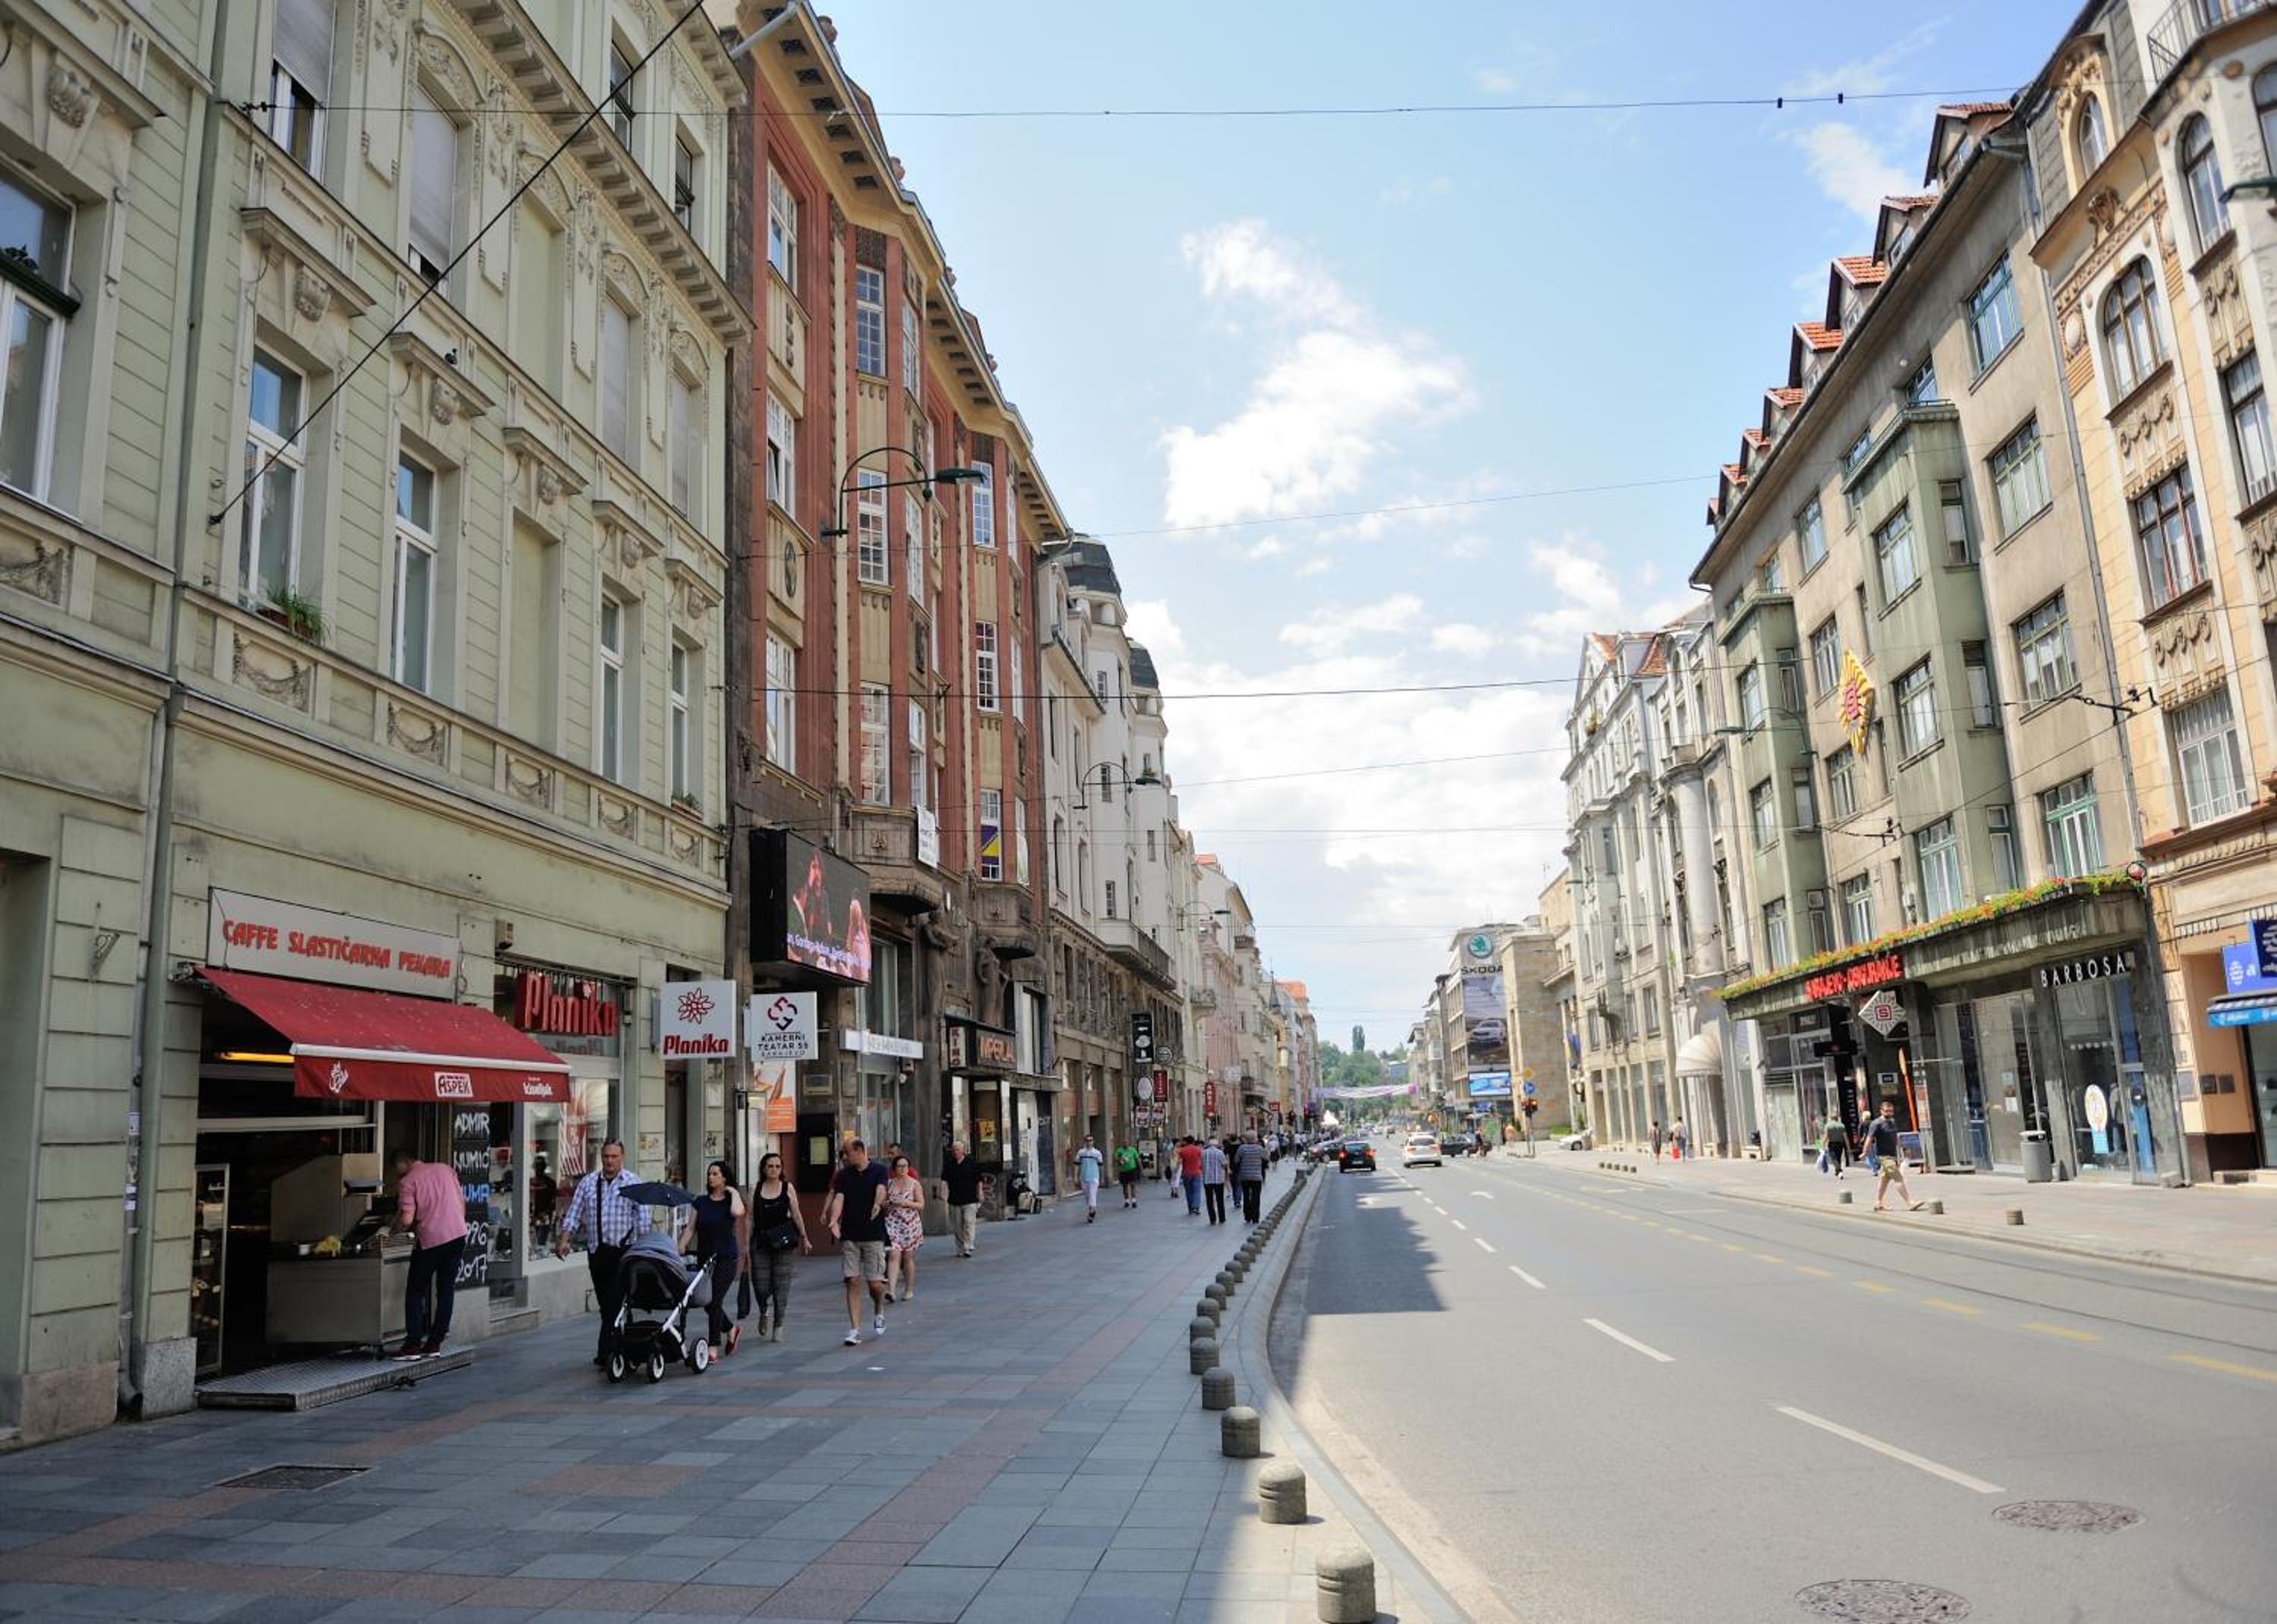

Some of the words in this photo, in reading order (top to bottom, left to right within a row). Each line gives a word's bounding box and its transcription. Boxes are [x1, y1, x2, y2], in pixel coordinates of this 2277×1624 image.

[223, 920, 279, 949] CAFFE
[288, 931, 390, 969] SLASTIČARNA
[2040, 952, 2126, 987] BARBOSA
[521, 971, 617, 1037] Planika
[663, 1033, 729, 1054] Planika
[758, 1042, 795, 1051] TEATAR
[454, 1113, 490, 1135] ADMIR
[464, 1220, 488, 1245] 996
[455, 1254, 487, 1283] 2017
